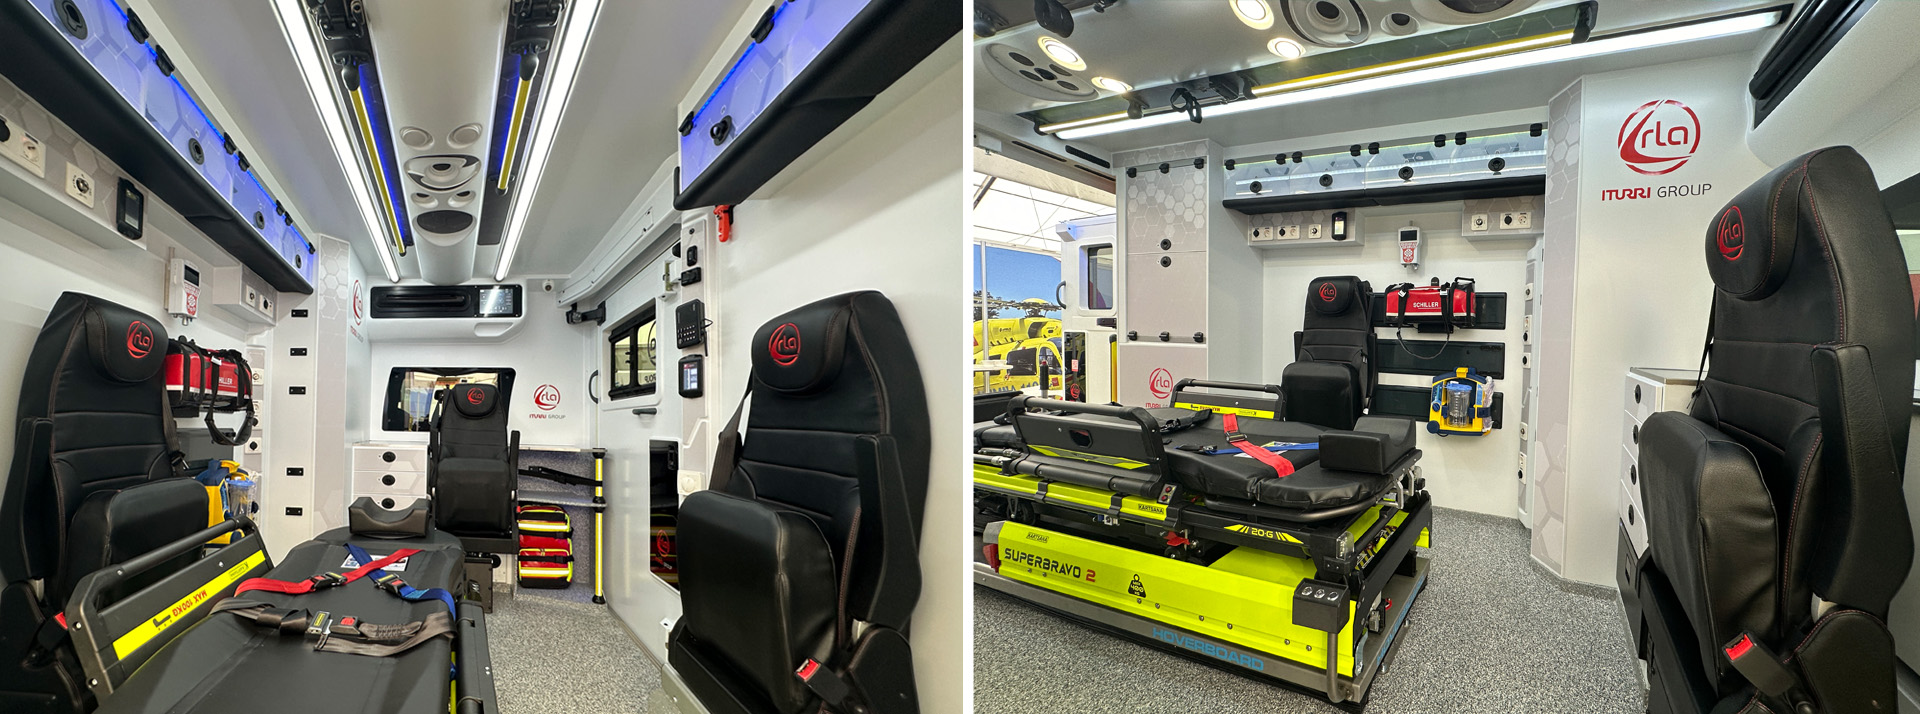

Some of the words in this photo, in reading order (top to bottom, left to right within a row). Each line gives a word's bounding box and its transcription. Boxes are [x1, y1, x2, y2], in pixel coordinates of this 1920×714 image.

[1641, 121, 1689, 149] rla
[1602, 187, 1651, 201] ITURRI
[1657, 183, 1712, 198] GROUP
[1137, 504, 1164, 514] KARTSANA
[1004, 547, 1081, 578] SUPERBRAVO
[1085, 569, 1096, 582] 2
[193, 589, 207, 603] MAX
[1152, 627, 1264, 671] HOVERBOARD
